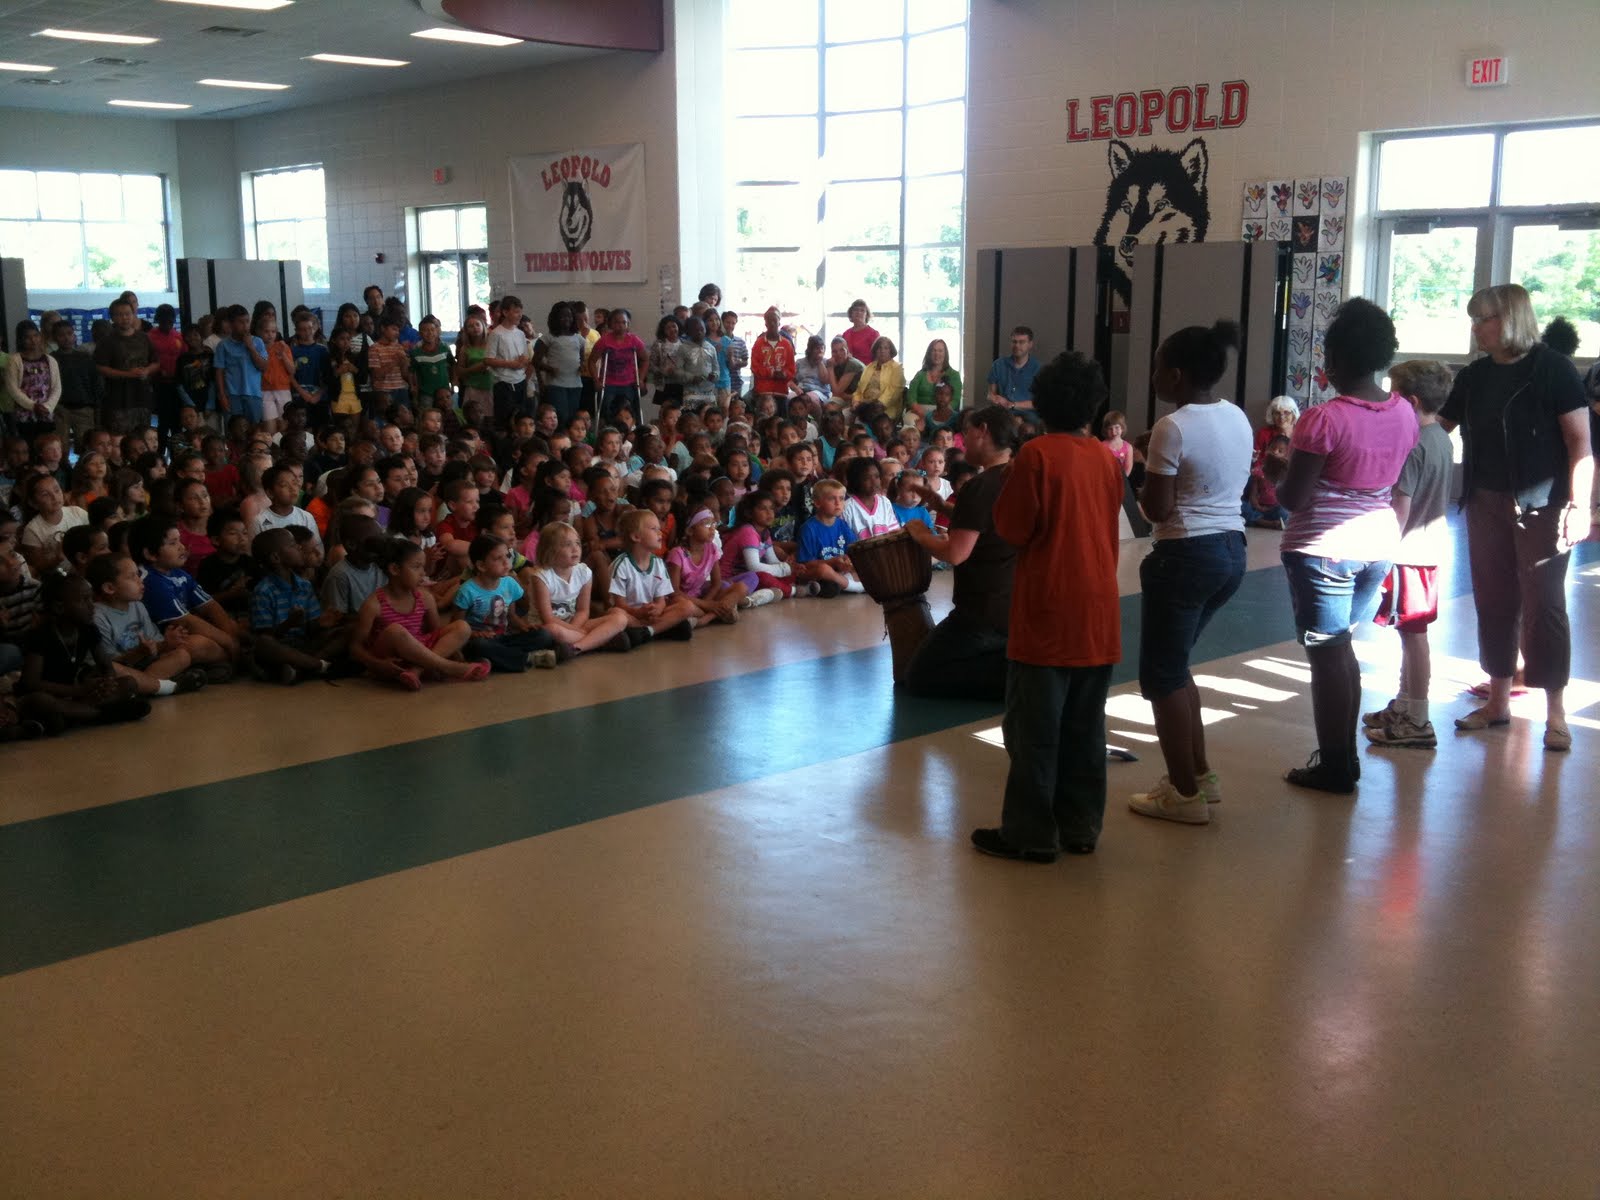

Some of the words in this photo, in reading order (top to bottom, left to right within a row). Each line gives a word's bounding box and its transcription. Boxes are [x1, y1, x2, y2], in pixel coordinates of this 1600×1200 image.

[1472, 58, 1502, 84] EXIT
[1066, 80, 1249, 142] LEOPOLD
[541, 155, 611, 191] LEOPOLD
[524, 251, 632, 272] TIMBERWOLVES
